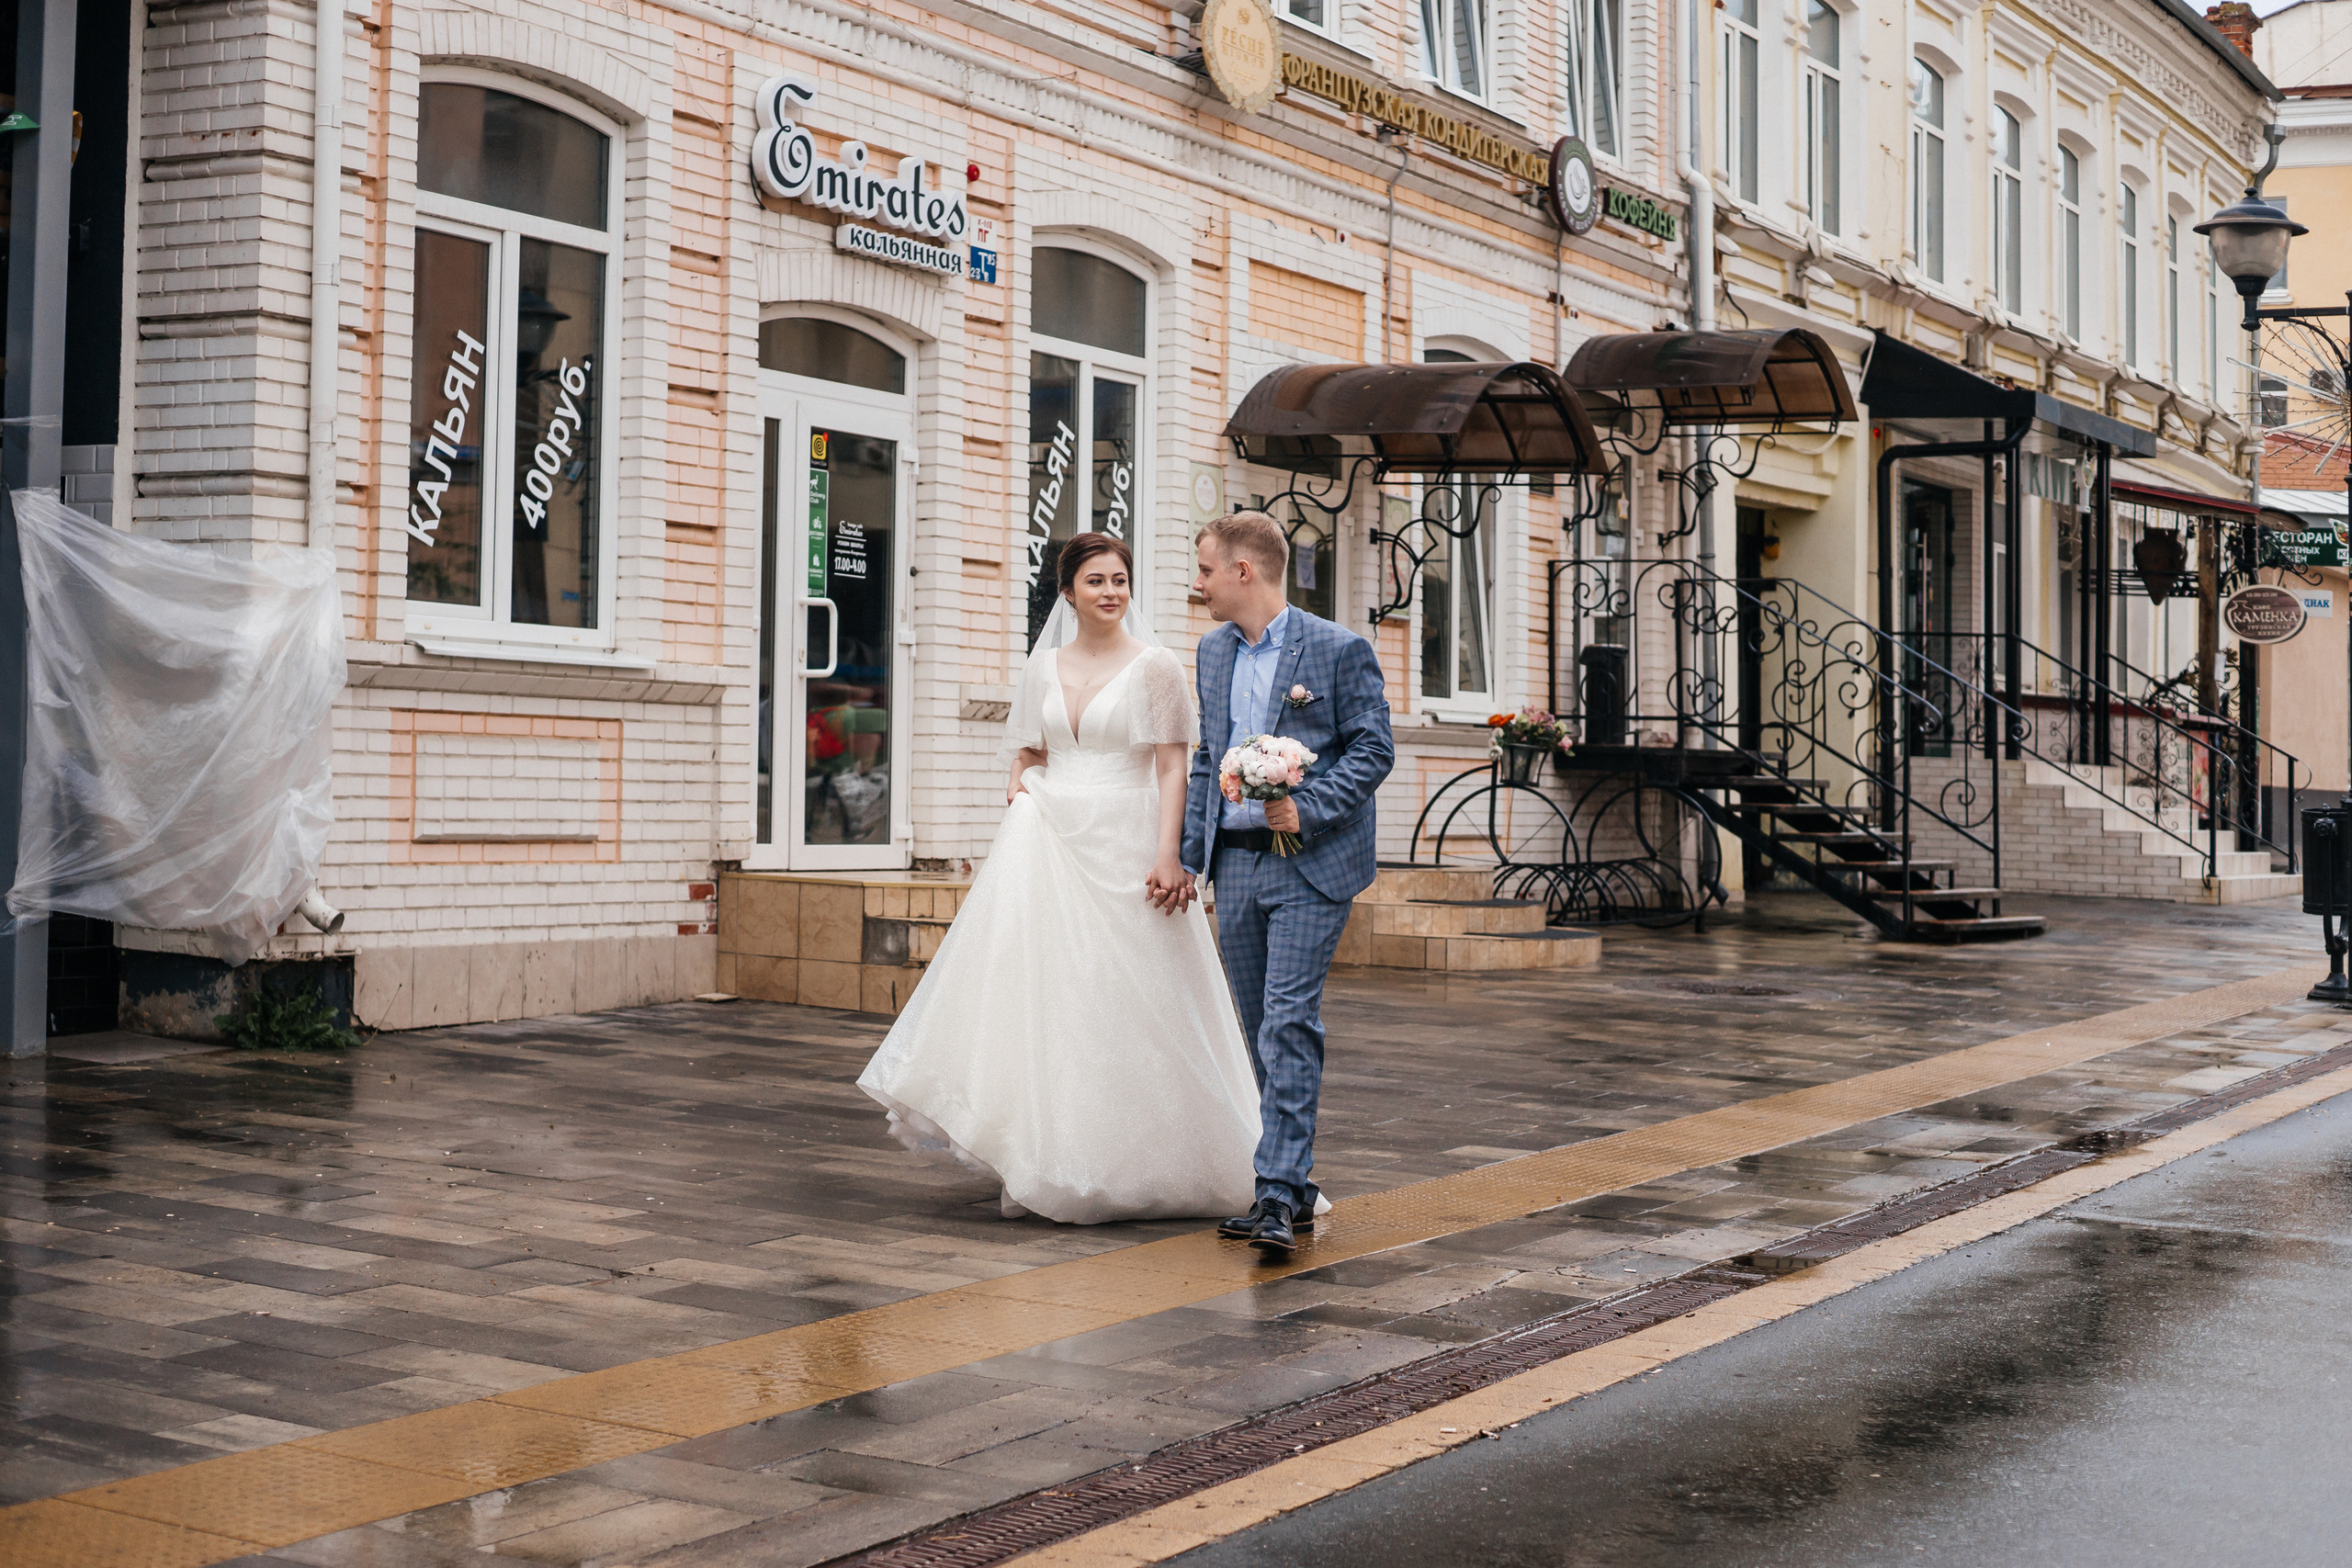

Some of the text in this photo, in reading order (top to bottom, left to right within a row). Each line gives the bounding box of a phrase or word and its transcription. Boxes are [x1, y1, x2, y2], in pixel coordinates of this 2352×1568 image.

[1285, 54, 1550, 186] ФРАНЦУЗСКАЯ КОНДИТЕРСКАЯ
[769, 84, 965, 235] Emirates
[1609, 187, 1678, 241] КОФЕЙНЯ
[849, 227, 962, 274] кальянная
[407, 329, 486, 547] КАЛЬЯН
[519, 356, 593, 530] 400руб.
[1102, 461, 1134, 540] руб.
[2269, 531, 2333, 544] ЕСТОРАН
[2233, 611, 2299, 623] КАМЕНКА
[2304, 599, 2330, 607] ДИАК
